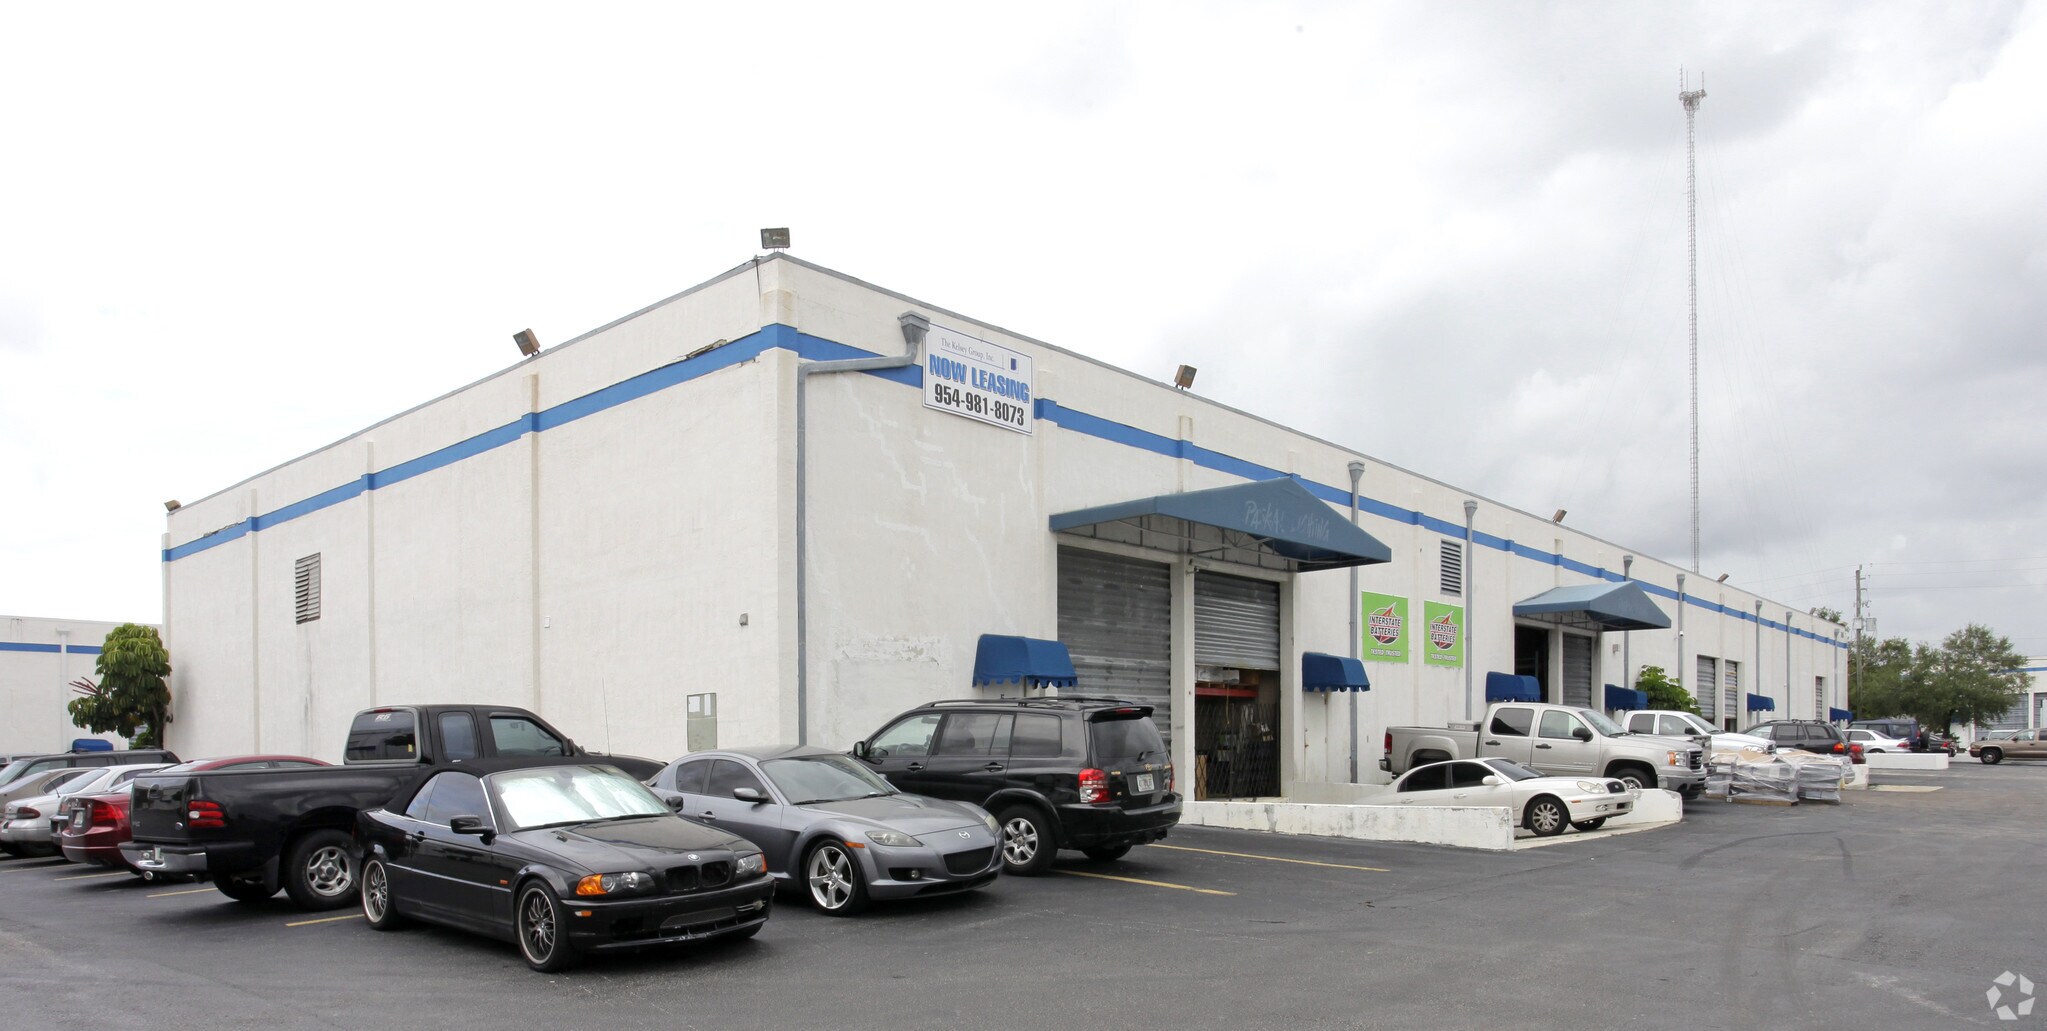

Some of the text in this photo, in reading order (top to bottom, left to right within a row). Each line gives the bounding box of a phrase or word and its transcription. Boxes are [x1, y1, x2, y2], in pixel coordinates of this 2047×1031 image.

[941, 338, 952, 349] The
[929, 354, 1029, 403] NOW LEASING
[934, 383, 1024, 426] 954-981-8073
[1369, 616, 1401, 627] INTERSTATE
[1370, 626, 1399, 637] BATTERIES
[1430, 623, 1457, 634] INTERSTATE
[1431, 632, 1455, 643] BATTERIES
